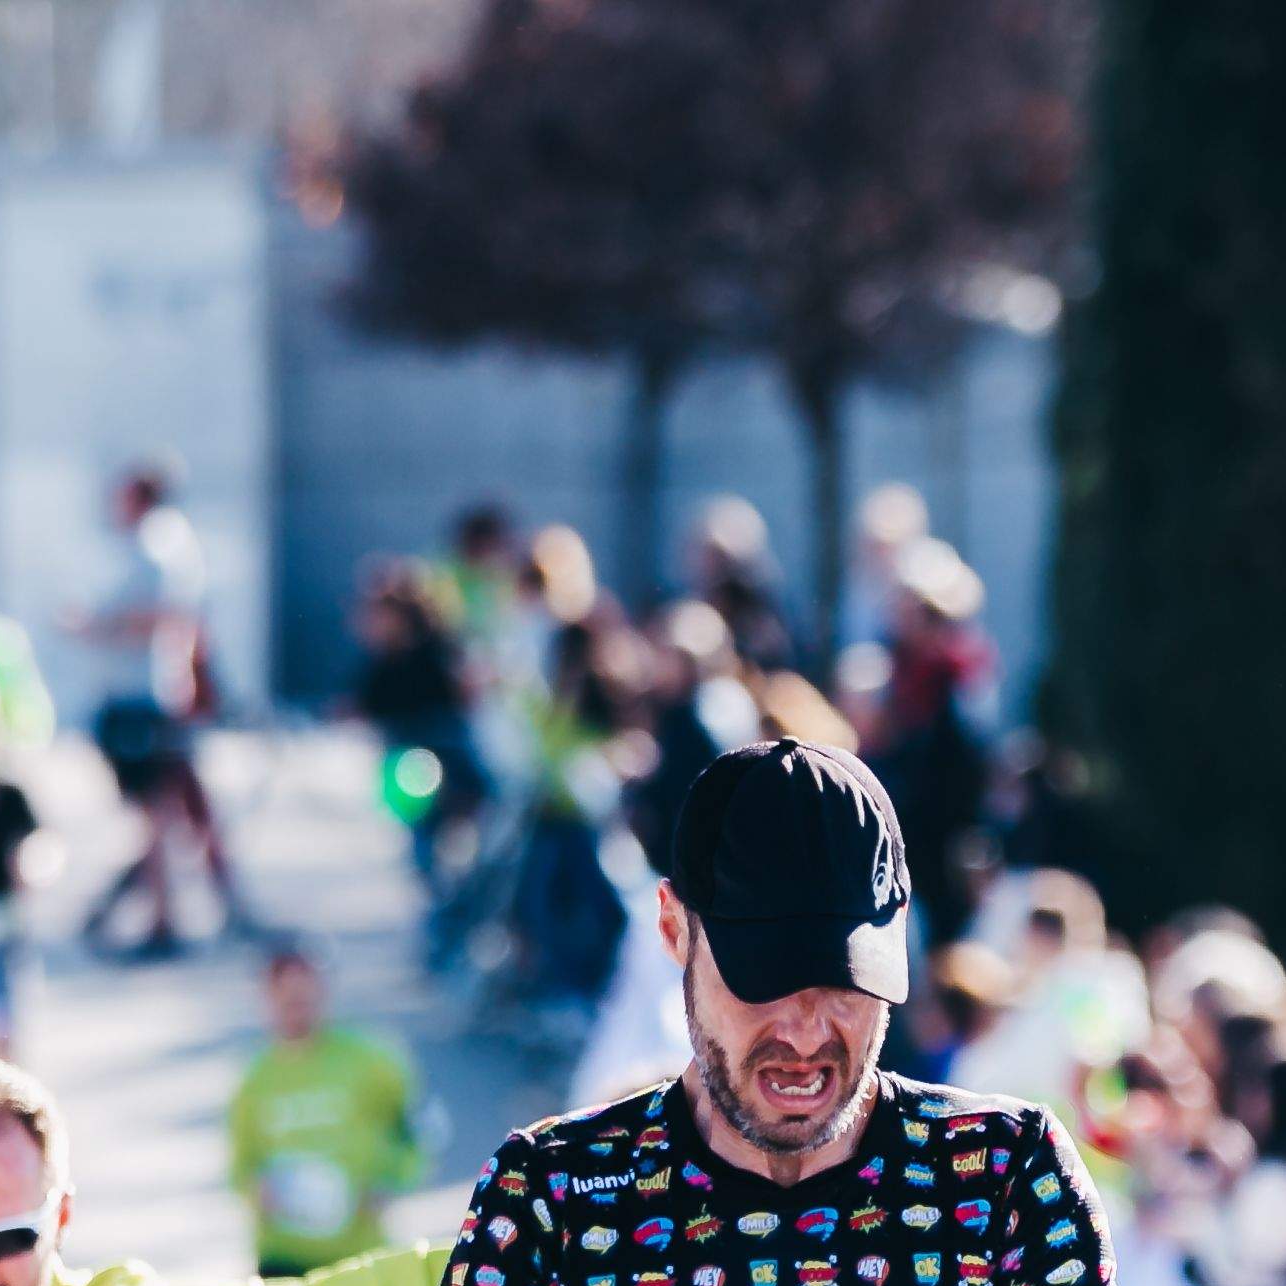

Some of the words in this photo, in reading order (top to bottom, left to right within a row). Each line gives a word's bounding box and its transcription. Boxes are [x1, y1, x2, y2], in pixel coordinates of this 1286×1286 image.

[953, 1147, 987, 1172] COOL!
[572, 1168, 636, 1194] luanvi
[636, 1167, 671, 1190] COOL!
[738, 1214, 780, 1233] SMILE!
[902, 1208, 942, 1223] SMILE!
[582, 1229, 619, 1249] SMILE!
[751, 1264, 778, 1284] OK
[857, 1257, 886, 1280] HEY
[914, 1258, 941, 1277] OK
